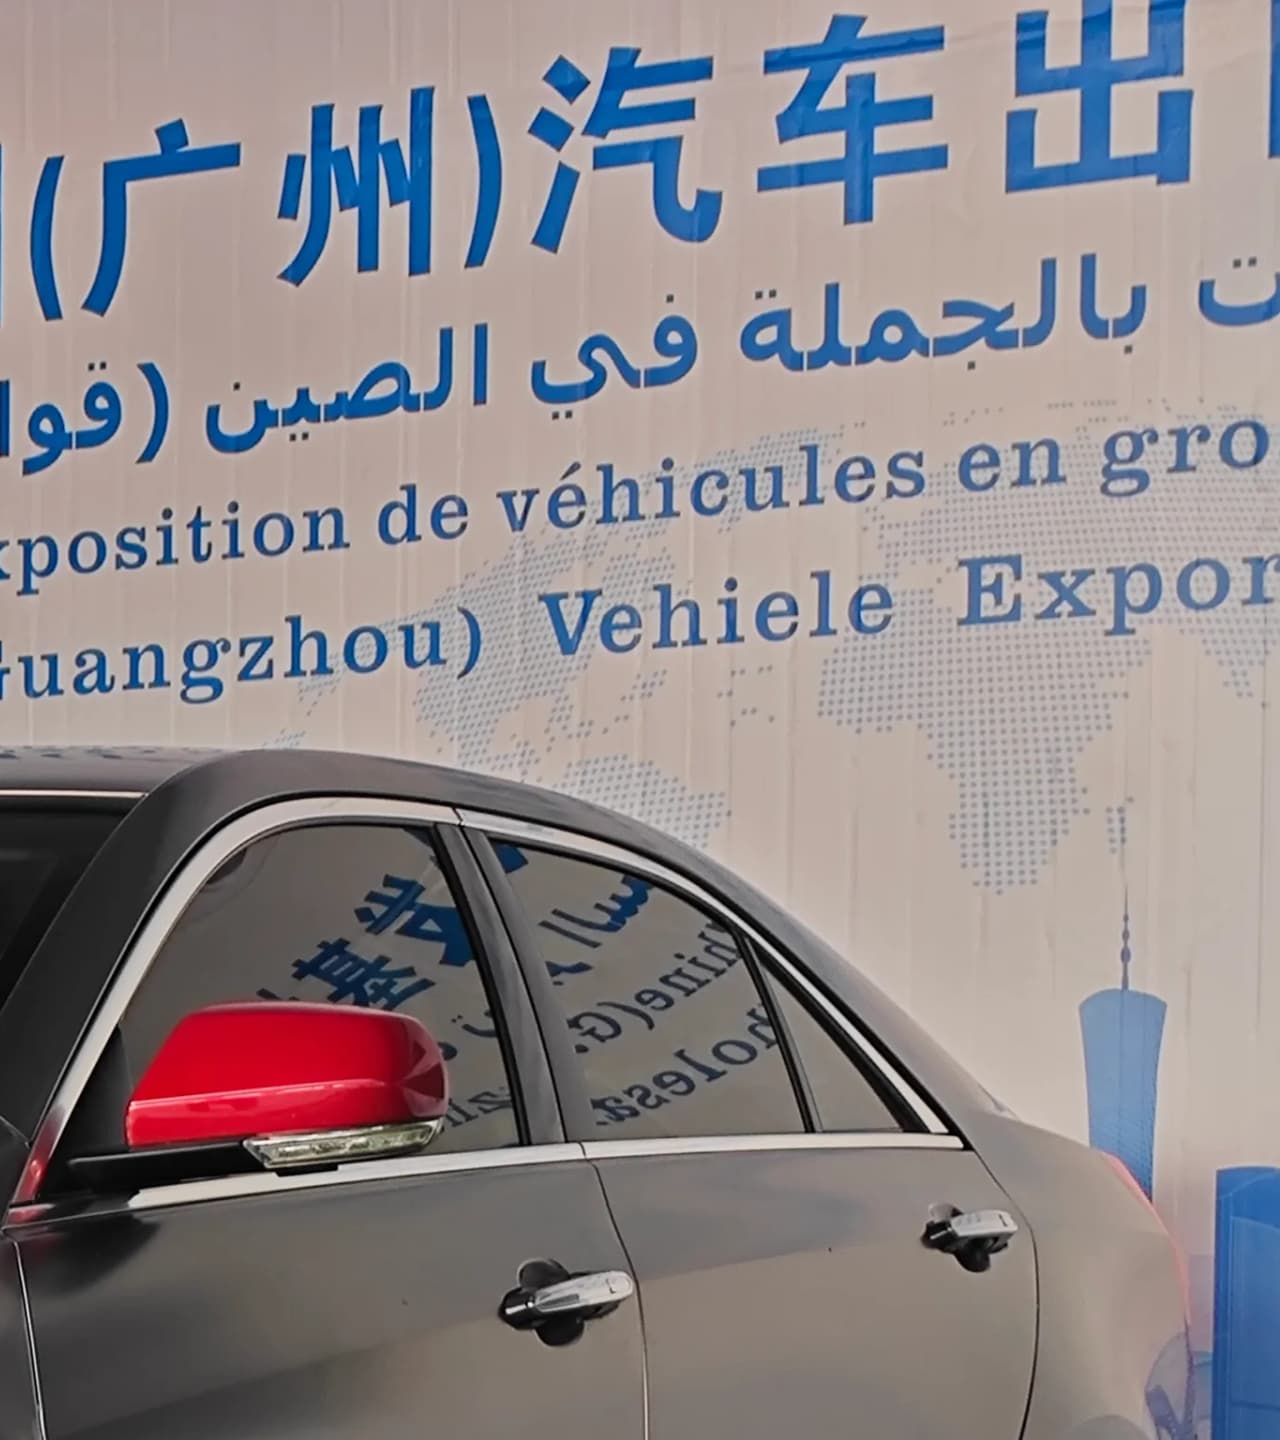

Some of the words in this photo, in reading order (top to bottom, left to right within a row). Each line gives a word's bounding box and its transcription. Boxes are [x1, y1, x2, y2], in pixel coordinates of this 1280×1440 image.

[529, 293, 699, 421] في
[739, 252, 1149, 373] بالجملة
[204, 322, 491, 455] الصين
[377, 484, 470, 545] de
[496, 444, 927, 536] véhicules
[956, 436, 1066, 493] en
[1098, 418, 1272, 498] gro
[538, 569, 896, 659] Vehiele
[955, 552, 1280, 638] Expor
